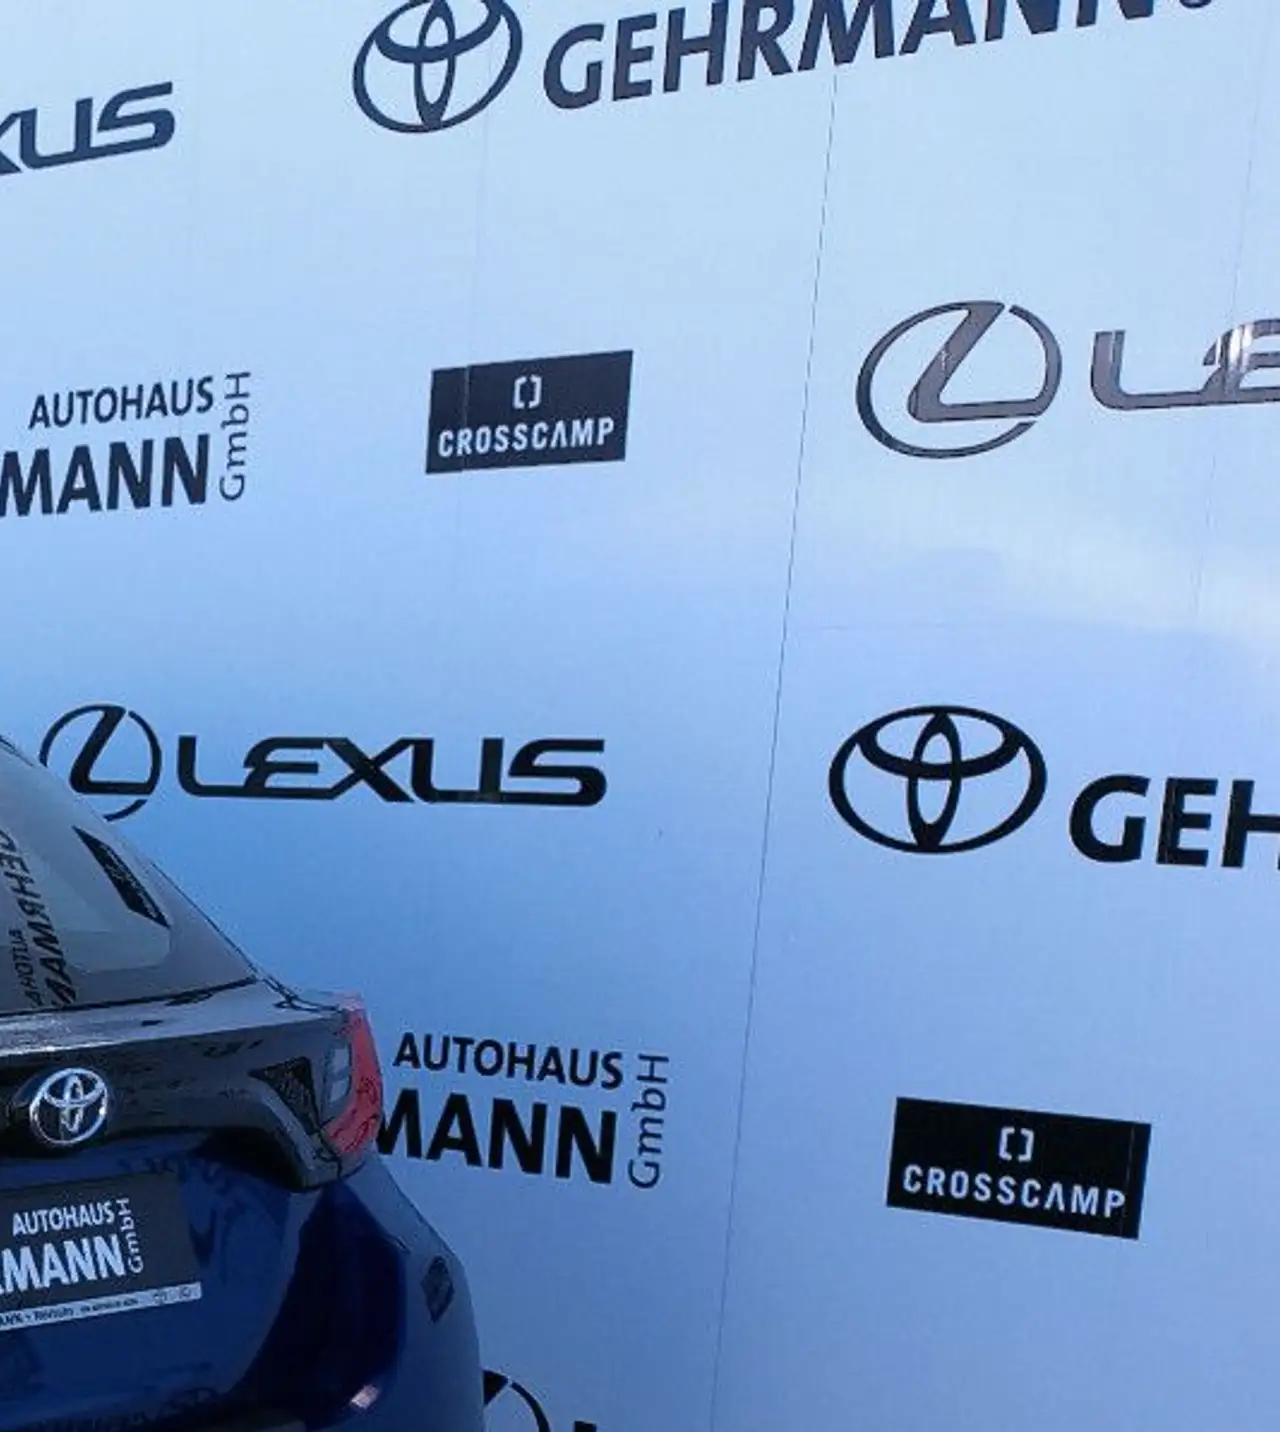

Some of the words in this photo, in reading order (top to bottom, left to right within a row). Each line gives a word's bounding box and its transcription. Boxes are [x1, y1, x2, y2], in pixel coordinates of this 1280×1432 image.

[543, 0, 1156, 110] GEHRMA
[28, 375, 214, 429] AUTOHAUS
[219, 371, 251, 502] GmbH
[438, 416, 616, 458] CROSSCAMP
[176, 735, 607, 807] LEXUS
[392, 1032, 624, 1090] AUTOHAUS
[627, 1053, 670, 1189] GmbH
[12, 1201, 115, 1237] AUTOHAUS
[901, 1164, 1127, 1220] CROSSCAMP
[116, 1198, 144, 1273] GmbH
